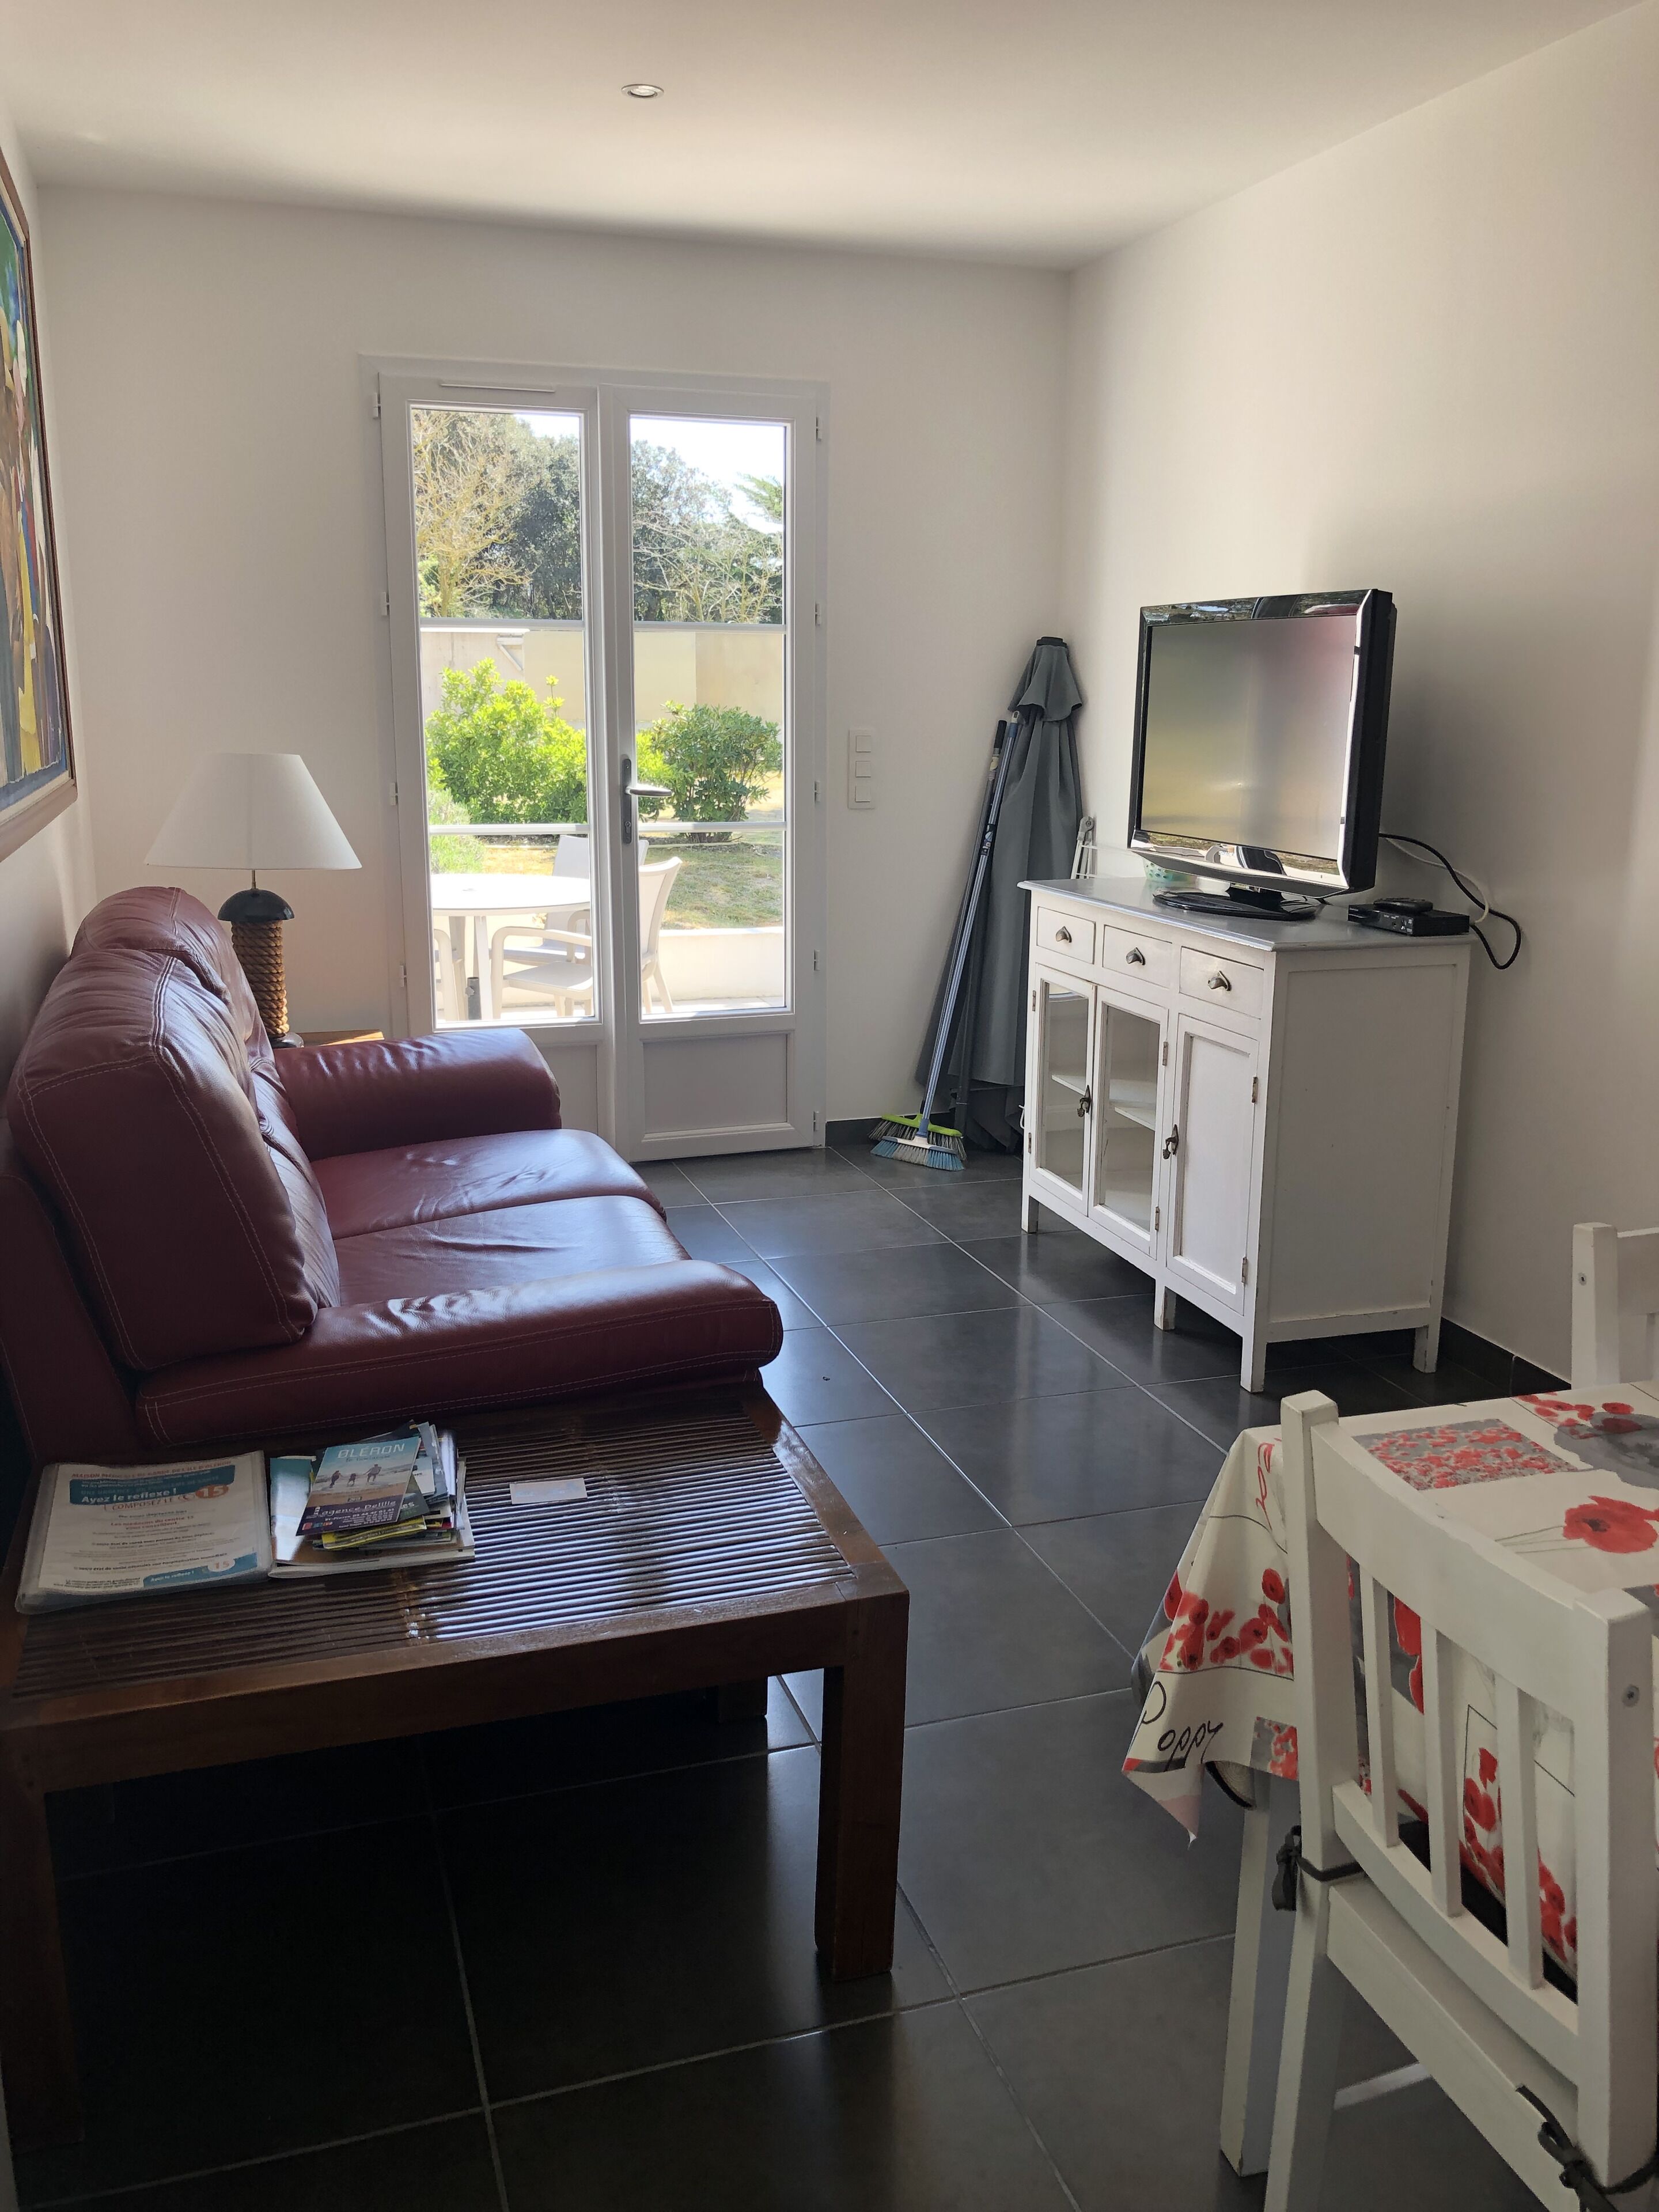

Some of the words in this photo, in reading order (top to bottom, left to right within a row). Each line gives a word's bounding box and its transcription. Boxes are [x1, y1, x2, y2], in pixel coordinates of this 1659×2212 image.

[202, 1487, 225, 1497] 15
[81, 1496, 110, 1504] Ayez
[1127, 1681, 1224, 1772] Poppy
